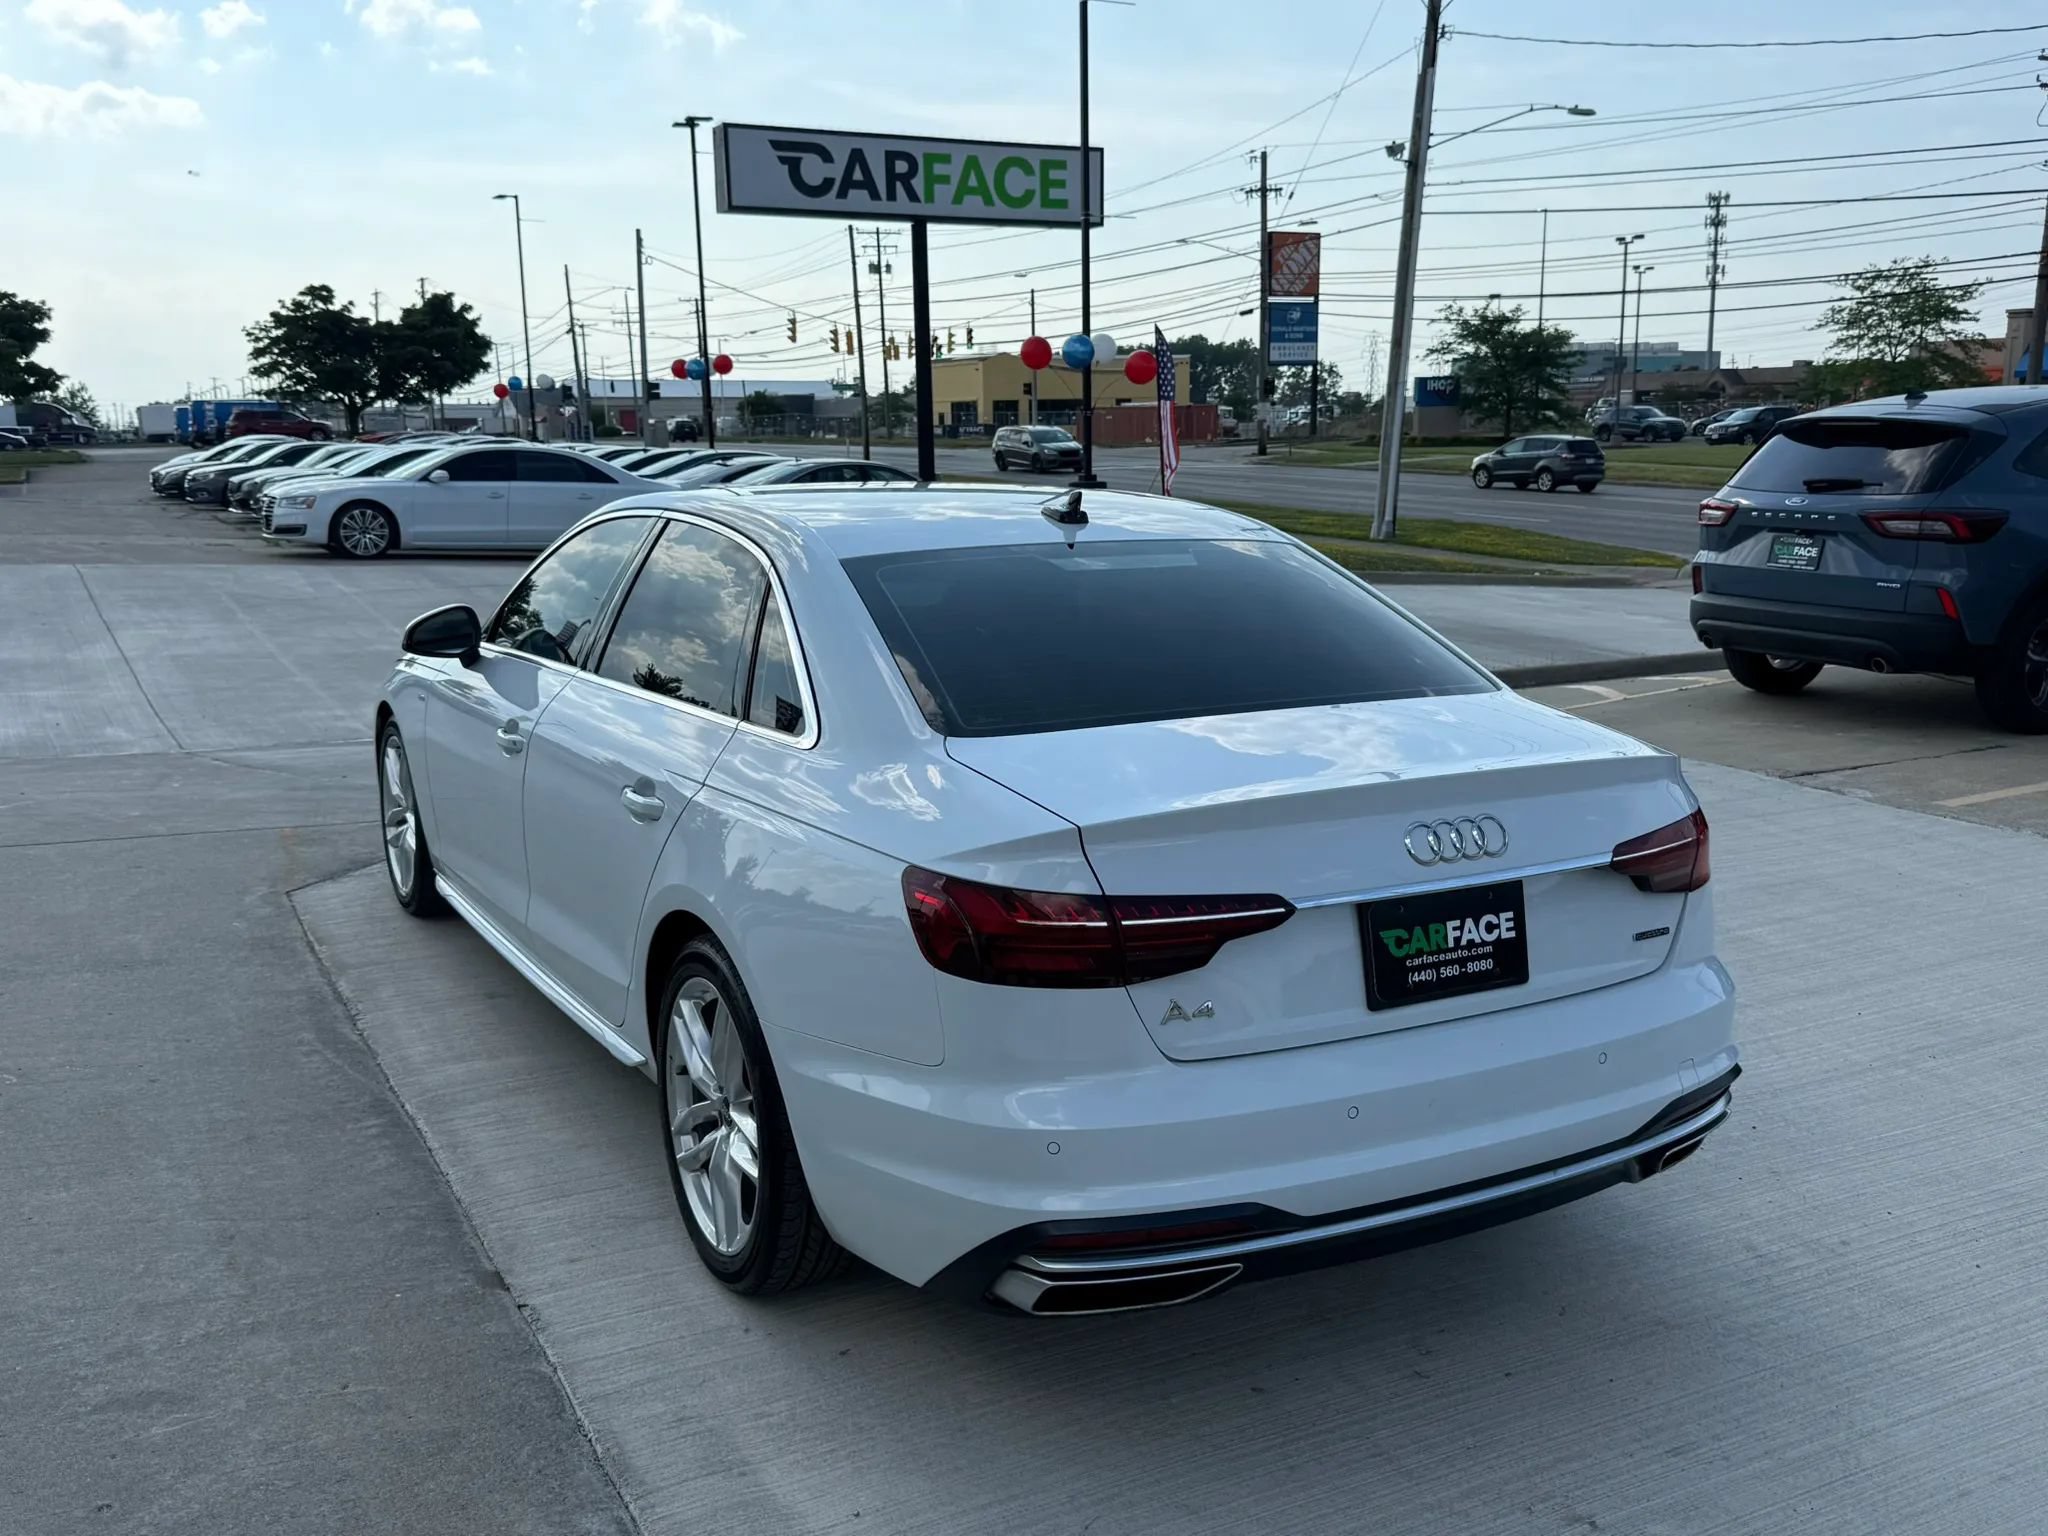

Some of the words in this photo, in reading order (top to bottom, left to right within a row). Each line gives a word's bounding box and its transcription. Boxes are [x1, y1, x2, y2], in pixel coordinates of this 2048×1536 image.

[767, 139, 1069, 210] CARFACE
[1379, 911, 1516, 957] CARFACE
[1406, 945, 1493, 967] carfaceauto.com
[1408, 968, 1437, 984] (440)
[1160, 999, 1215, 1025] A4
